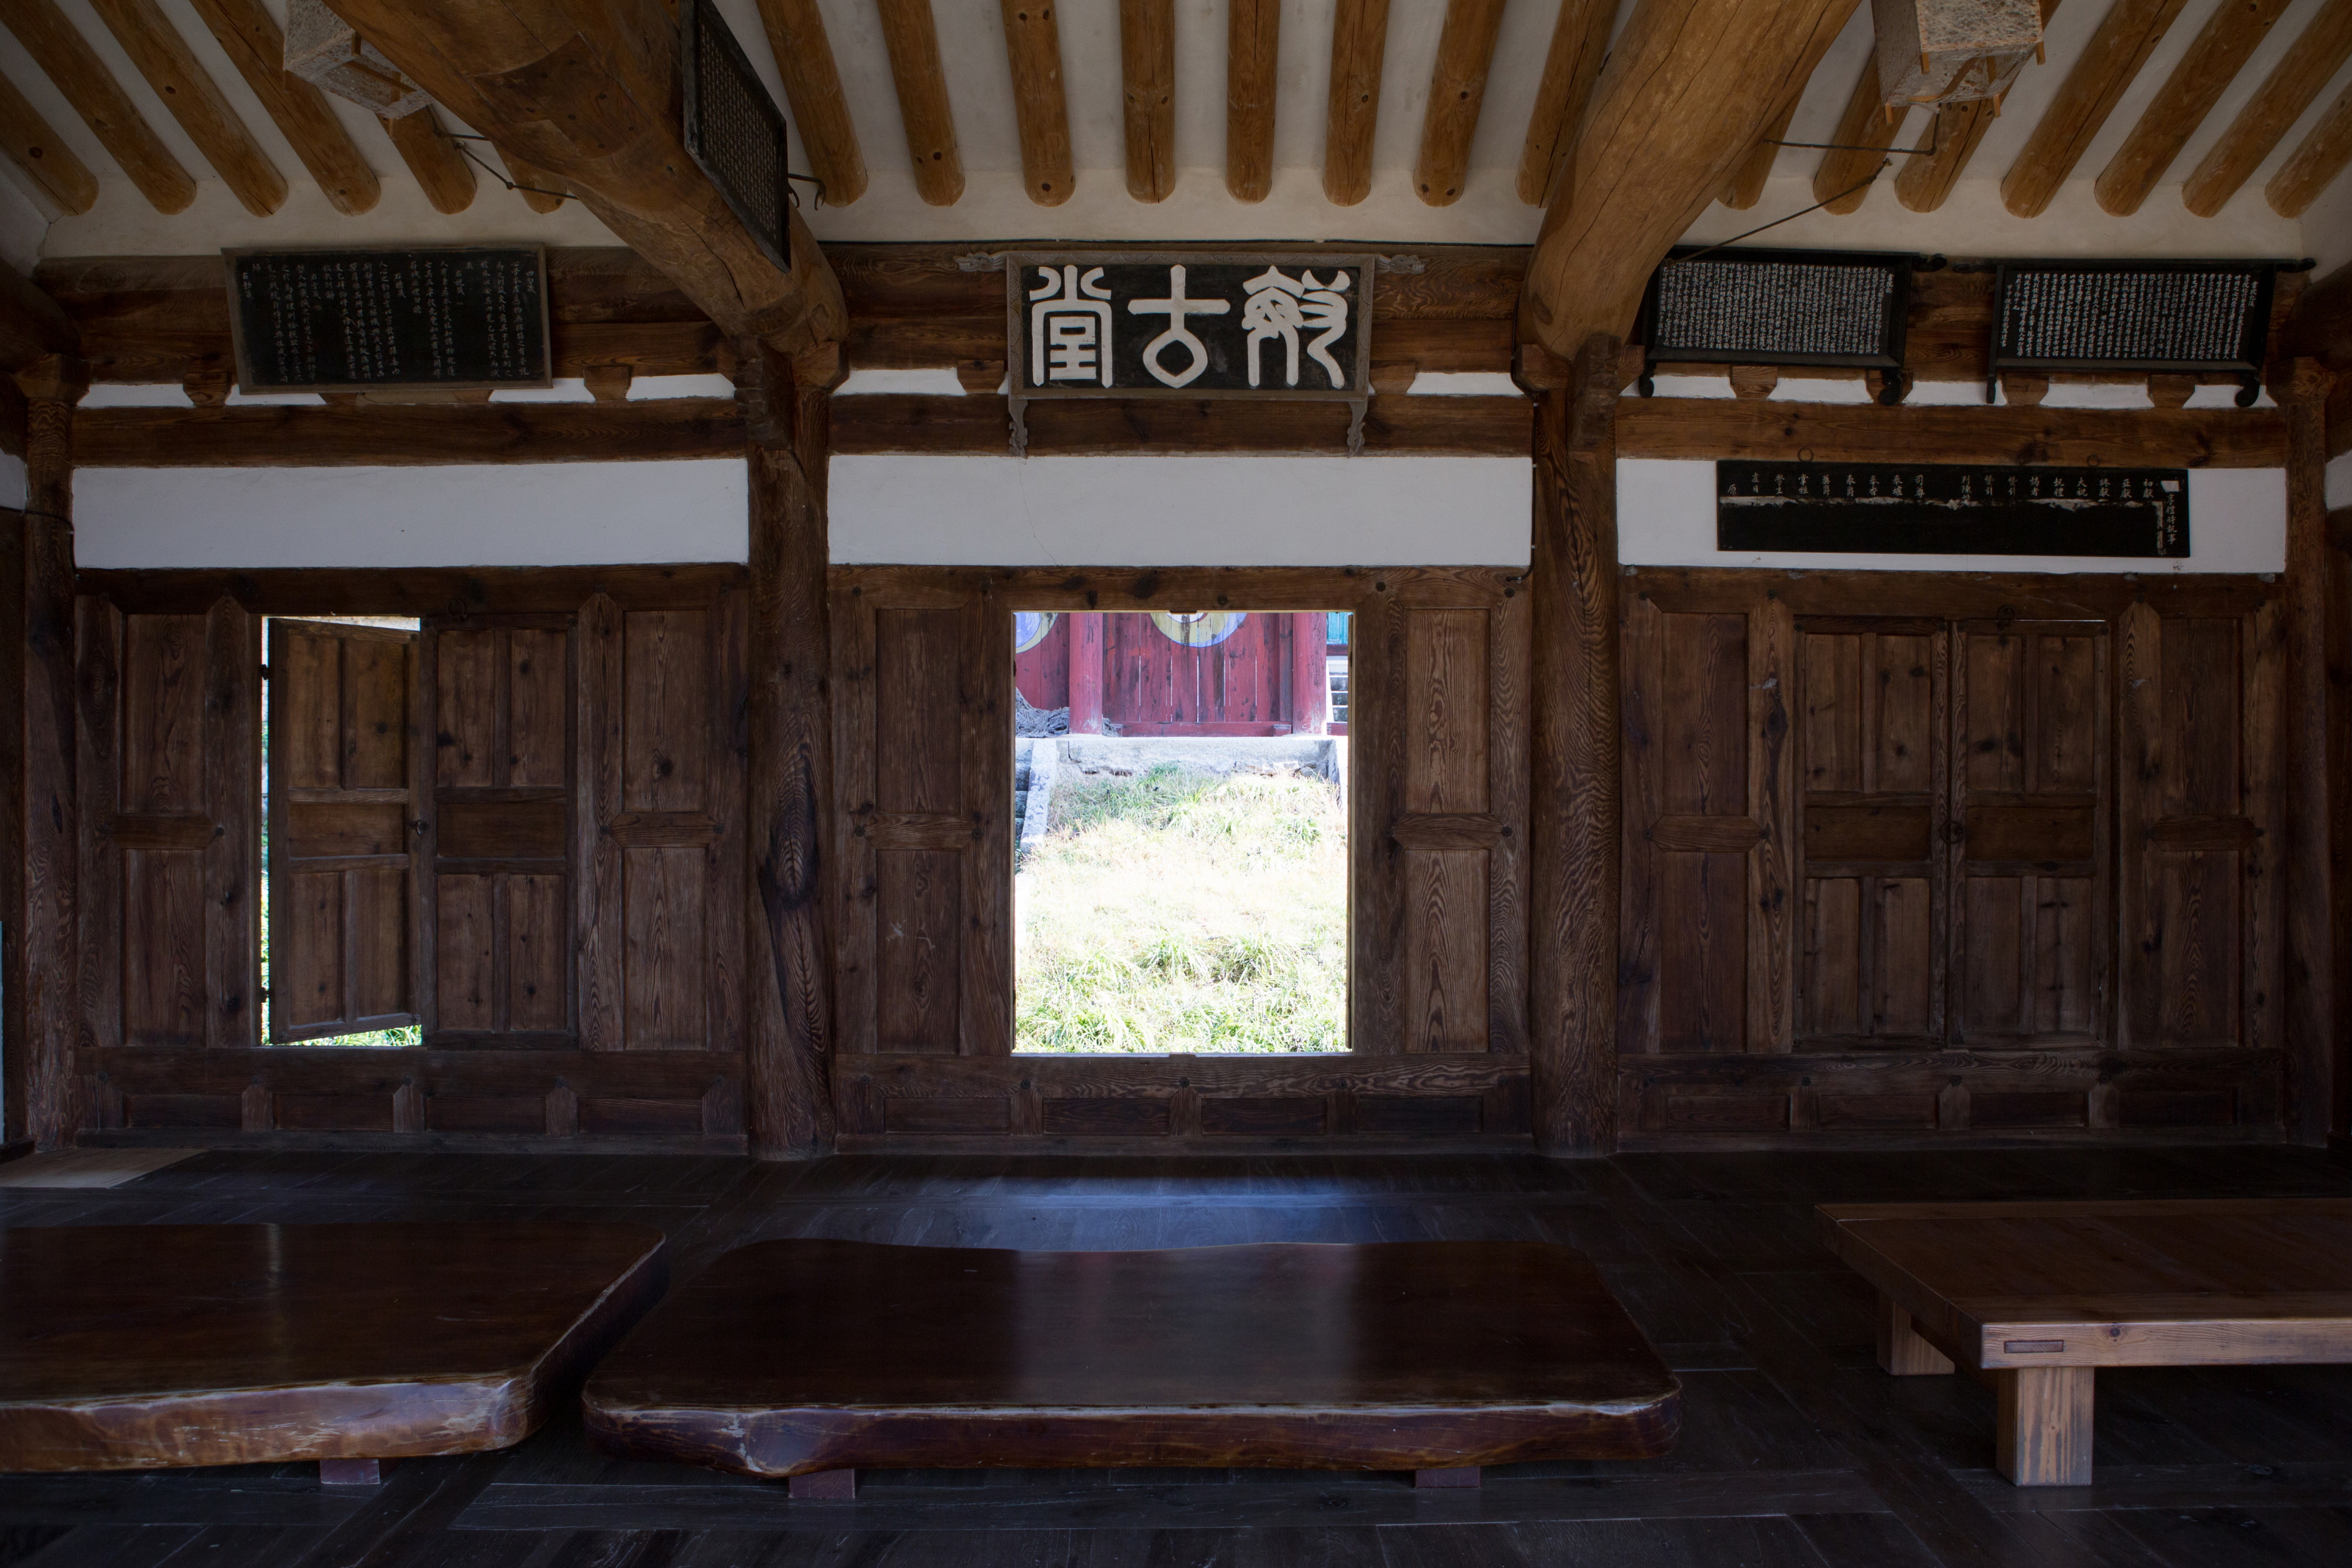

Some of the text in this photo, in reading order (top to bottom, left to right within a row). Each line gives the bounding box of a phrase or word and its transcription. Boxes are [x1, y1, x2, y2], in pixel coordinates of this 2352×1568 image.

[1751, 472, 1760, 494] 直日
[1798, 473, 1809, 494] 掌牲
[1846, 474, 1856, 497] 奉爵
[1869, 474, 1879, 496] 奉香
[1892, 474, 1903, 496] 奉爐
[2029, 477, 2040, 496] 謁者
[2077, 477, 2088, 497] 大祝
[2099, 478, 2111, 497] 終獻
[2120, 479, 2133, 499] 亞獻
[2143, 479, 2154, 499] 初獻
